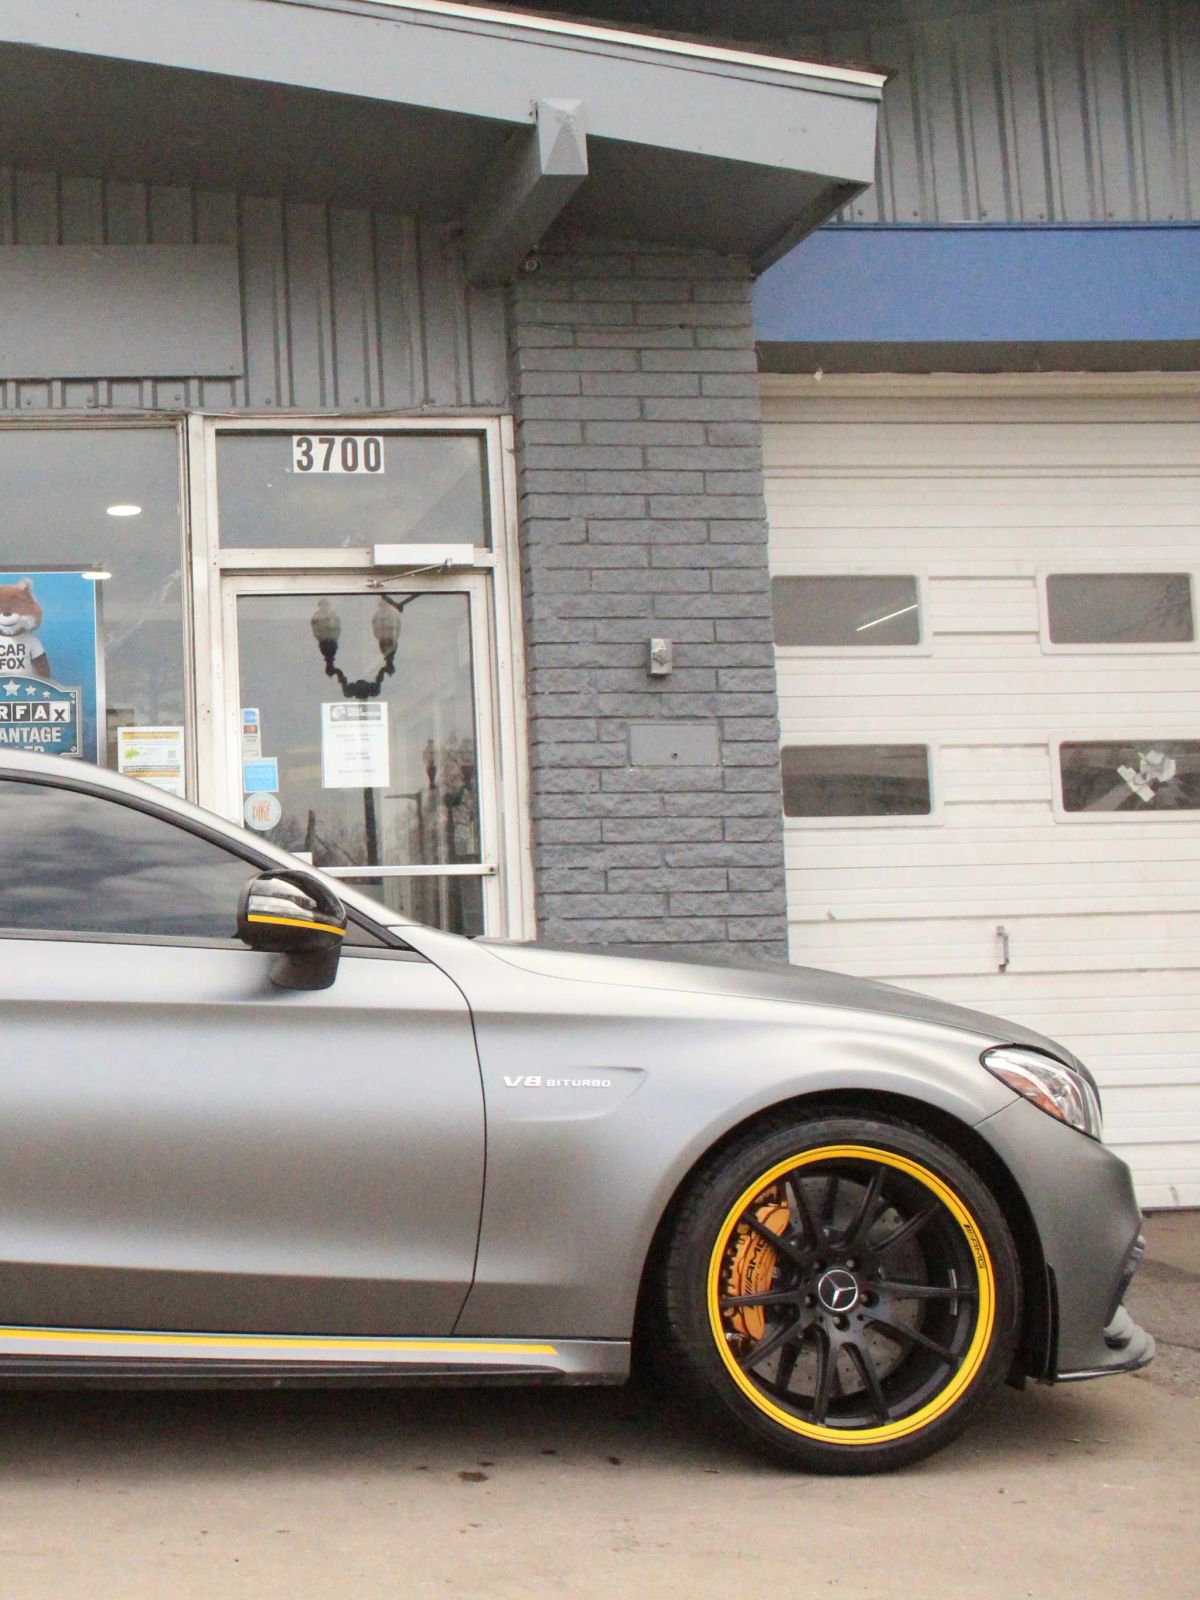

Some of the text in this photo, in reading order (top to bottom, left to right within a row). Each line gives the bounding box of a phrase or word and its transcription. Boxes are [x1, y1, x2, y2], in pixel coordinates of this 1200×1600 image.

[296, 437, 381, 472] 3700
[0, 658, 25, 670] FOX
[503, 1076, 611, 1087] V8 BITURBO
